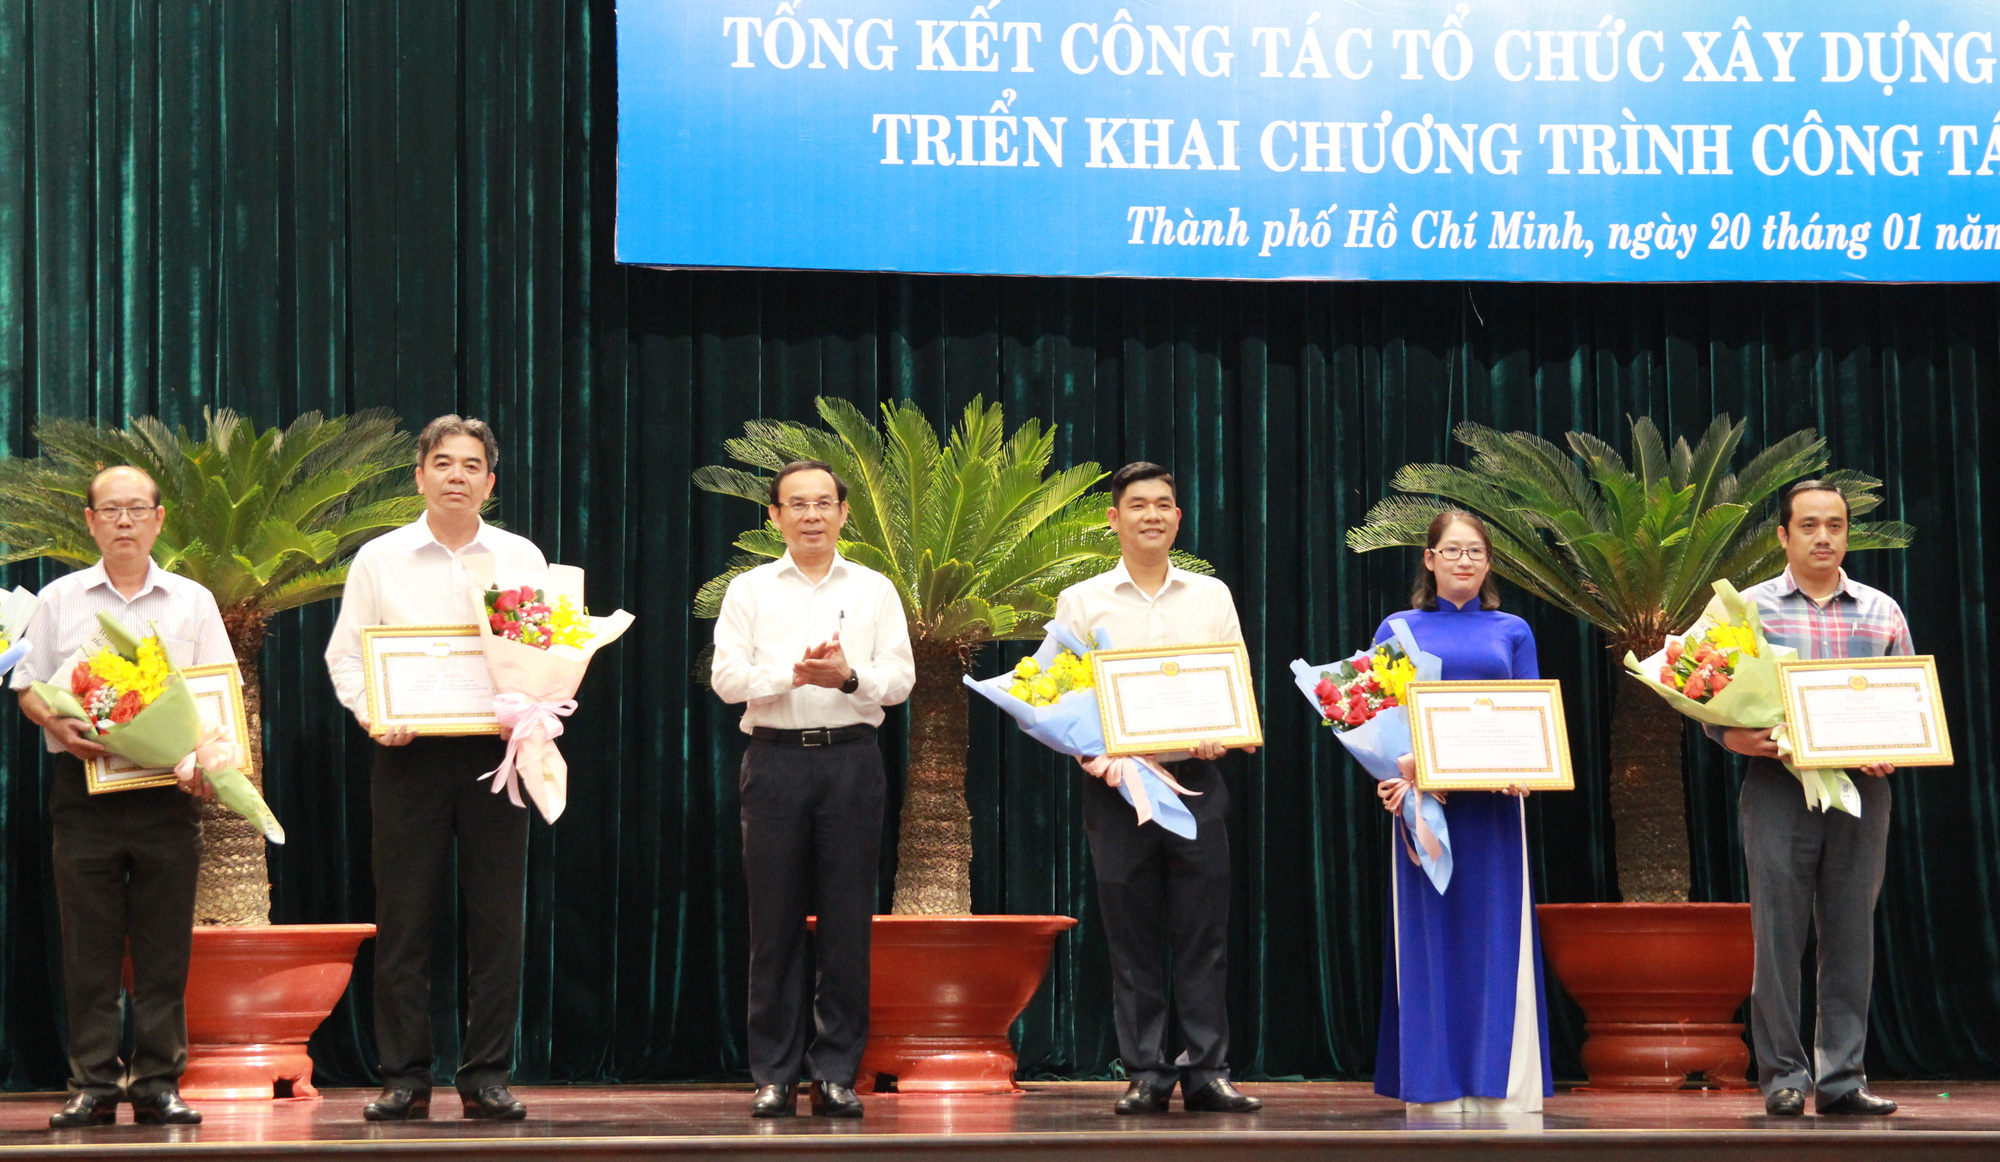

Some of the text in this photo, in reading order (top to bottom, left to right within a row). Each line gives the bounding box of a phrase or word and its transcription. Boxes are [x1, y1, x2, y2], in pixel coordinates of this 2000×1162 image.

[915, 0, 1042, 73] KẾT
[1060, 8, 1235, 78] CÔNG
[1252, 11, 1373, 80] TÁC
[1392, 3, 1474, 82] TỔ
[1494, 13, 1665, 83] CHỨC
[1681, 15, 1804, 83] XÂY
[1819, 19, 1997, 97] DỰNG
[872, 87, 1068, 168] TRIỂN
[1084, 117, 1241, 171] KHAI
[1259, 109, 1523, 176] CHƯƠNG
[1539, 107, 1733, 176] TRÌNH
[1751, 109, 1924, 177] CÔNG
[1126, 205, 1250, 247] Thành
[1258, 203, 1338, 257] phố
[1343, 202, 1398, 249] Hồ
[1411, 209, 1478, 250] Chí
[1487, 210, 1594, 258] Minh,
[1608, 211, 1697, 260] ngày
[1708, 212, 1751, 250] 20
[1762, 211, 1872, 260] tháng
[1883, 212, 1922, 251] 01
